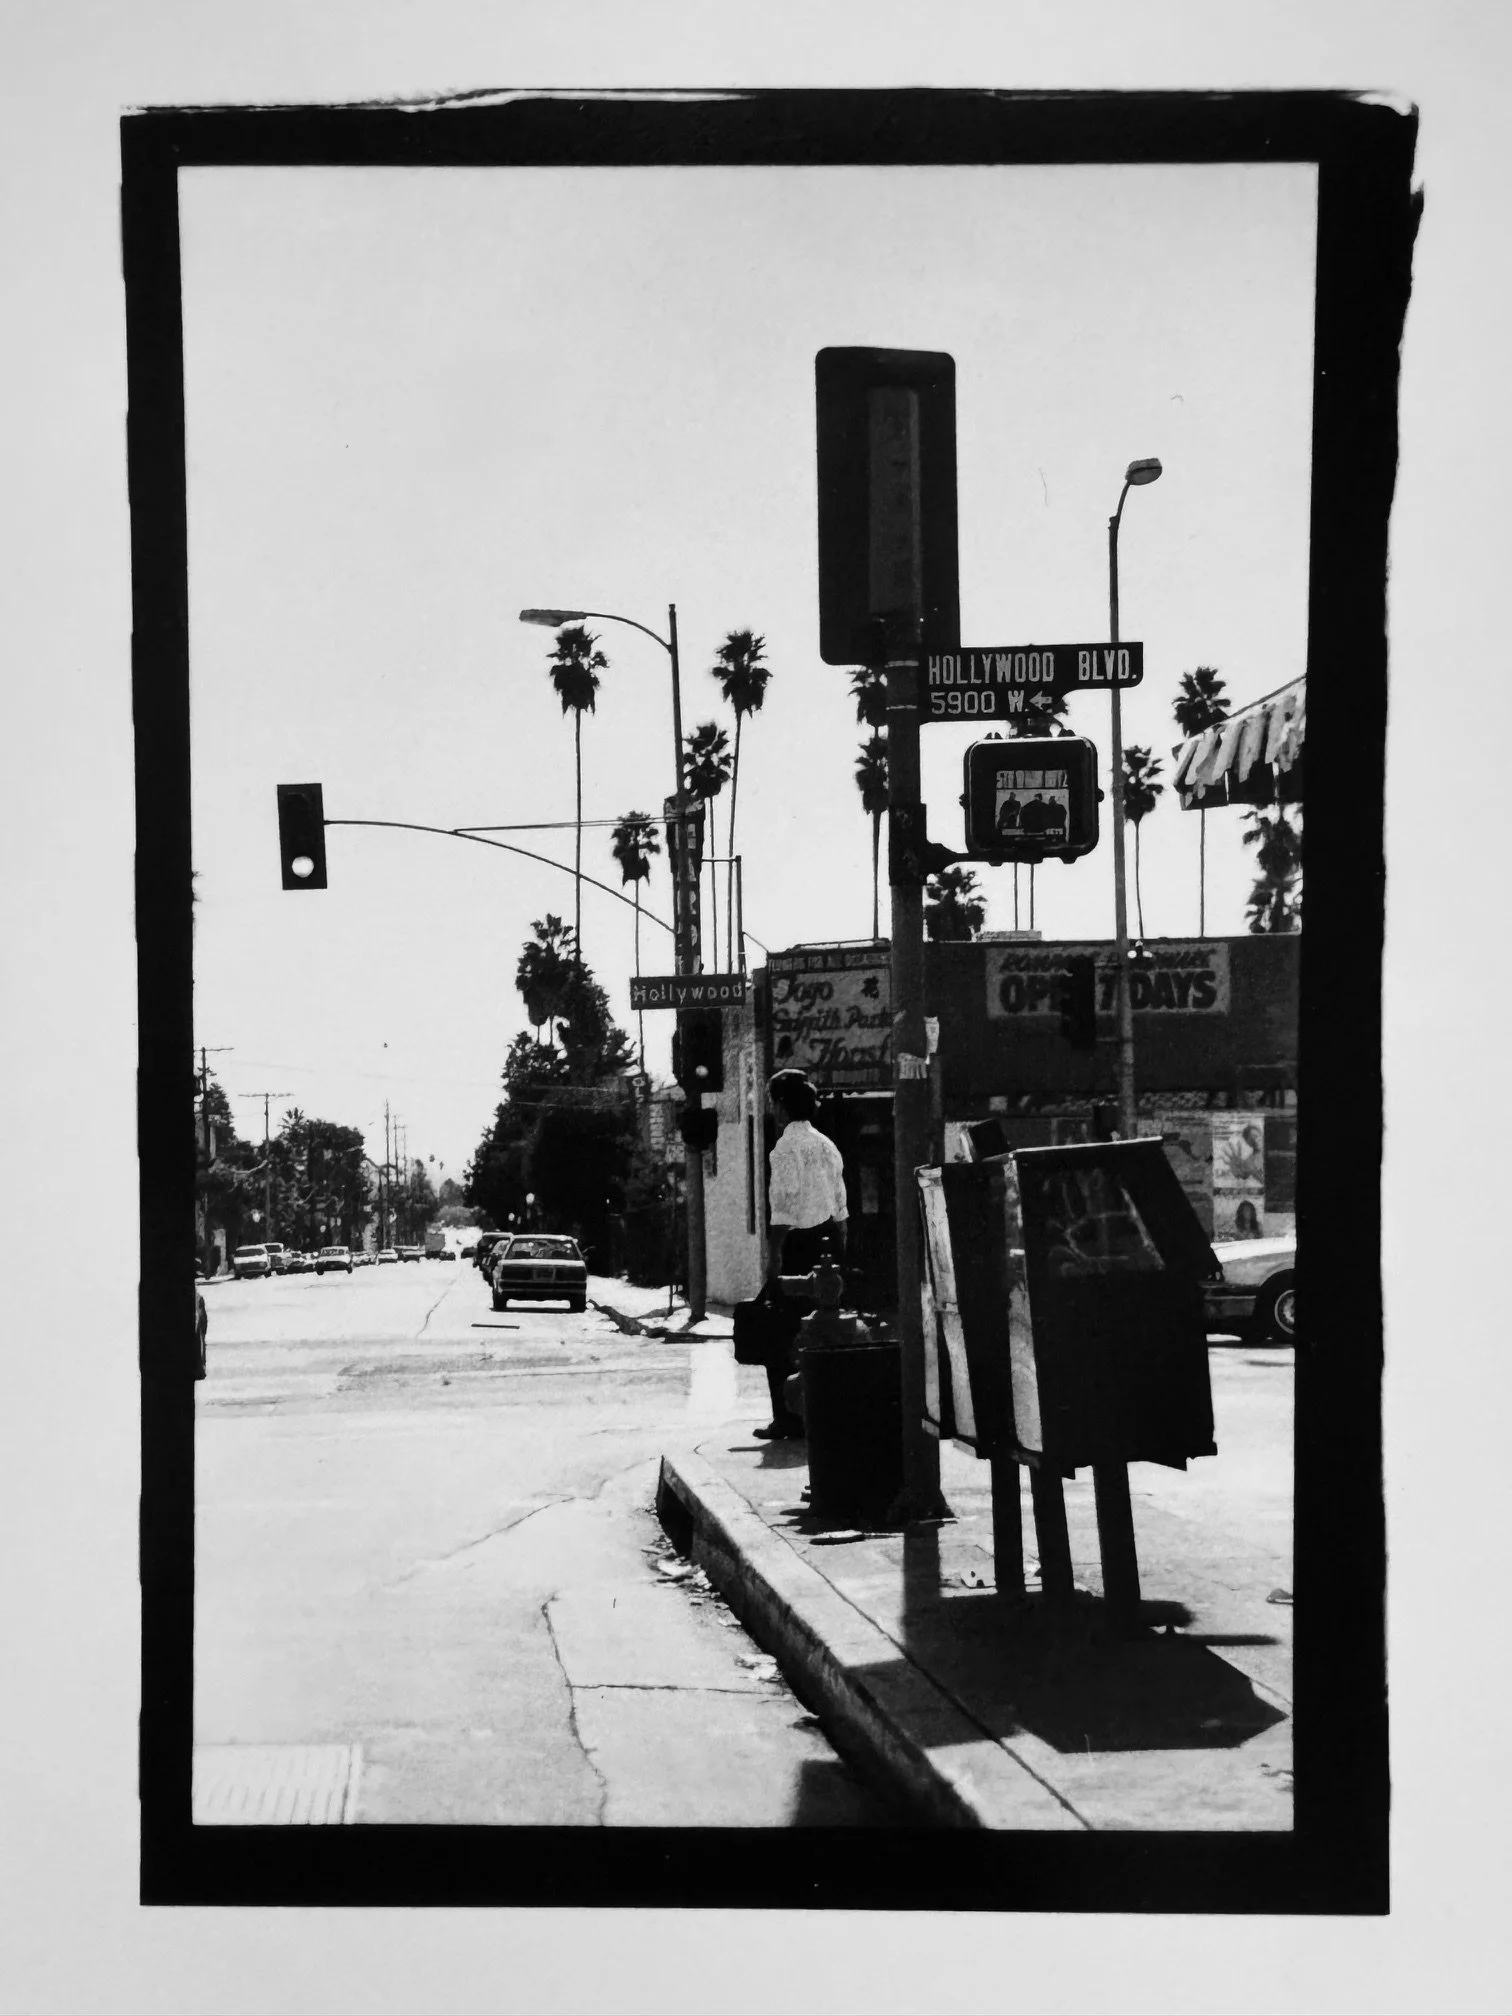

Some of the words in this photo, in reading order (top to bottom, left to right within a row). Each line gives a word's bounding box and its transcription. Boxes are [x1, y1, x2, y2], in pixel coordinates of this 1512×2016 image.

[928, 652, 1055, 685] HOLLYWOOD
[1078, 649, 1137, 681] BLVD.
[930, 690, 996, 714] 5900
[633, 982, 743, 1005] Hollywood
[1129, 969, 1218, 1011] DAYS
